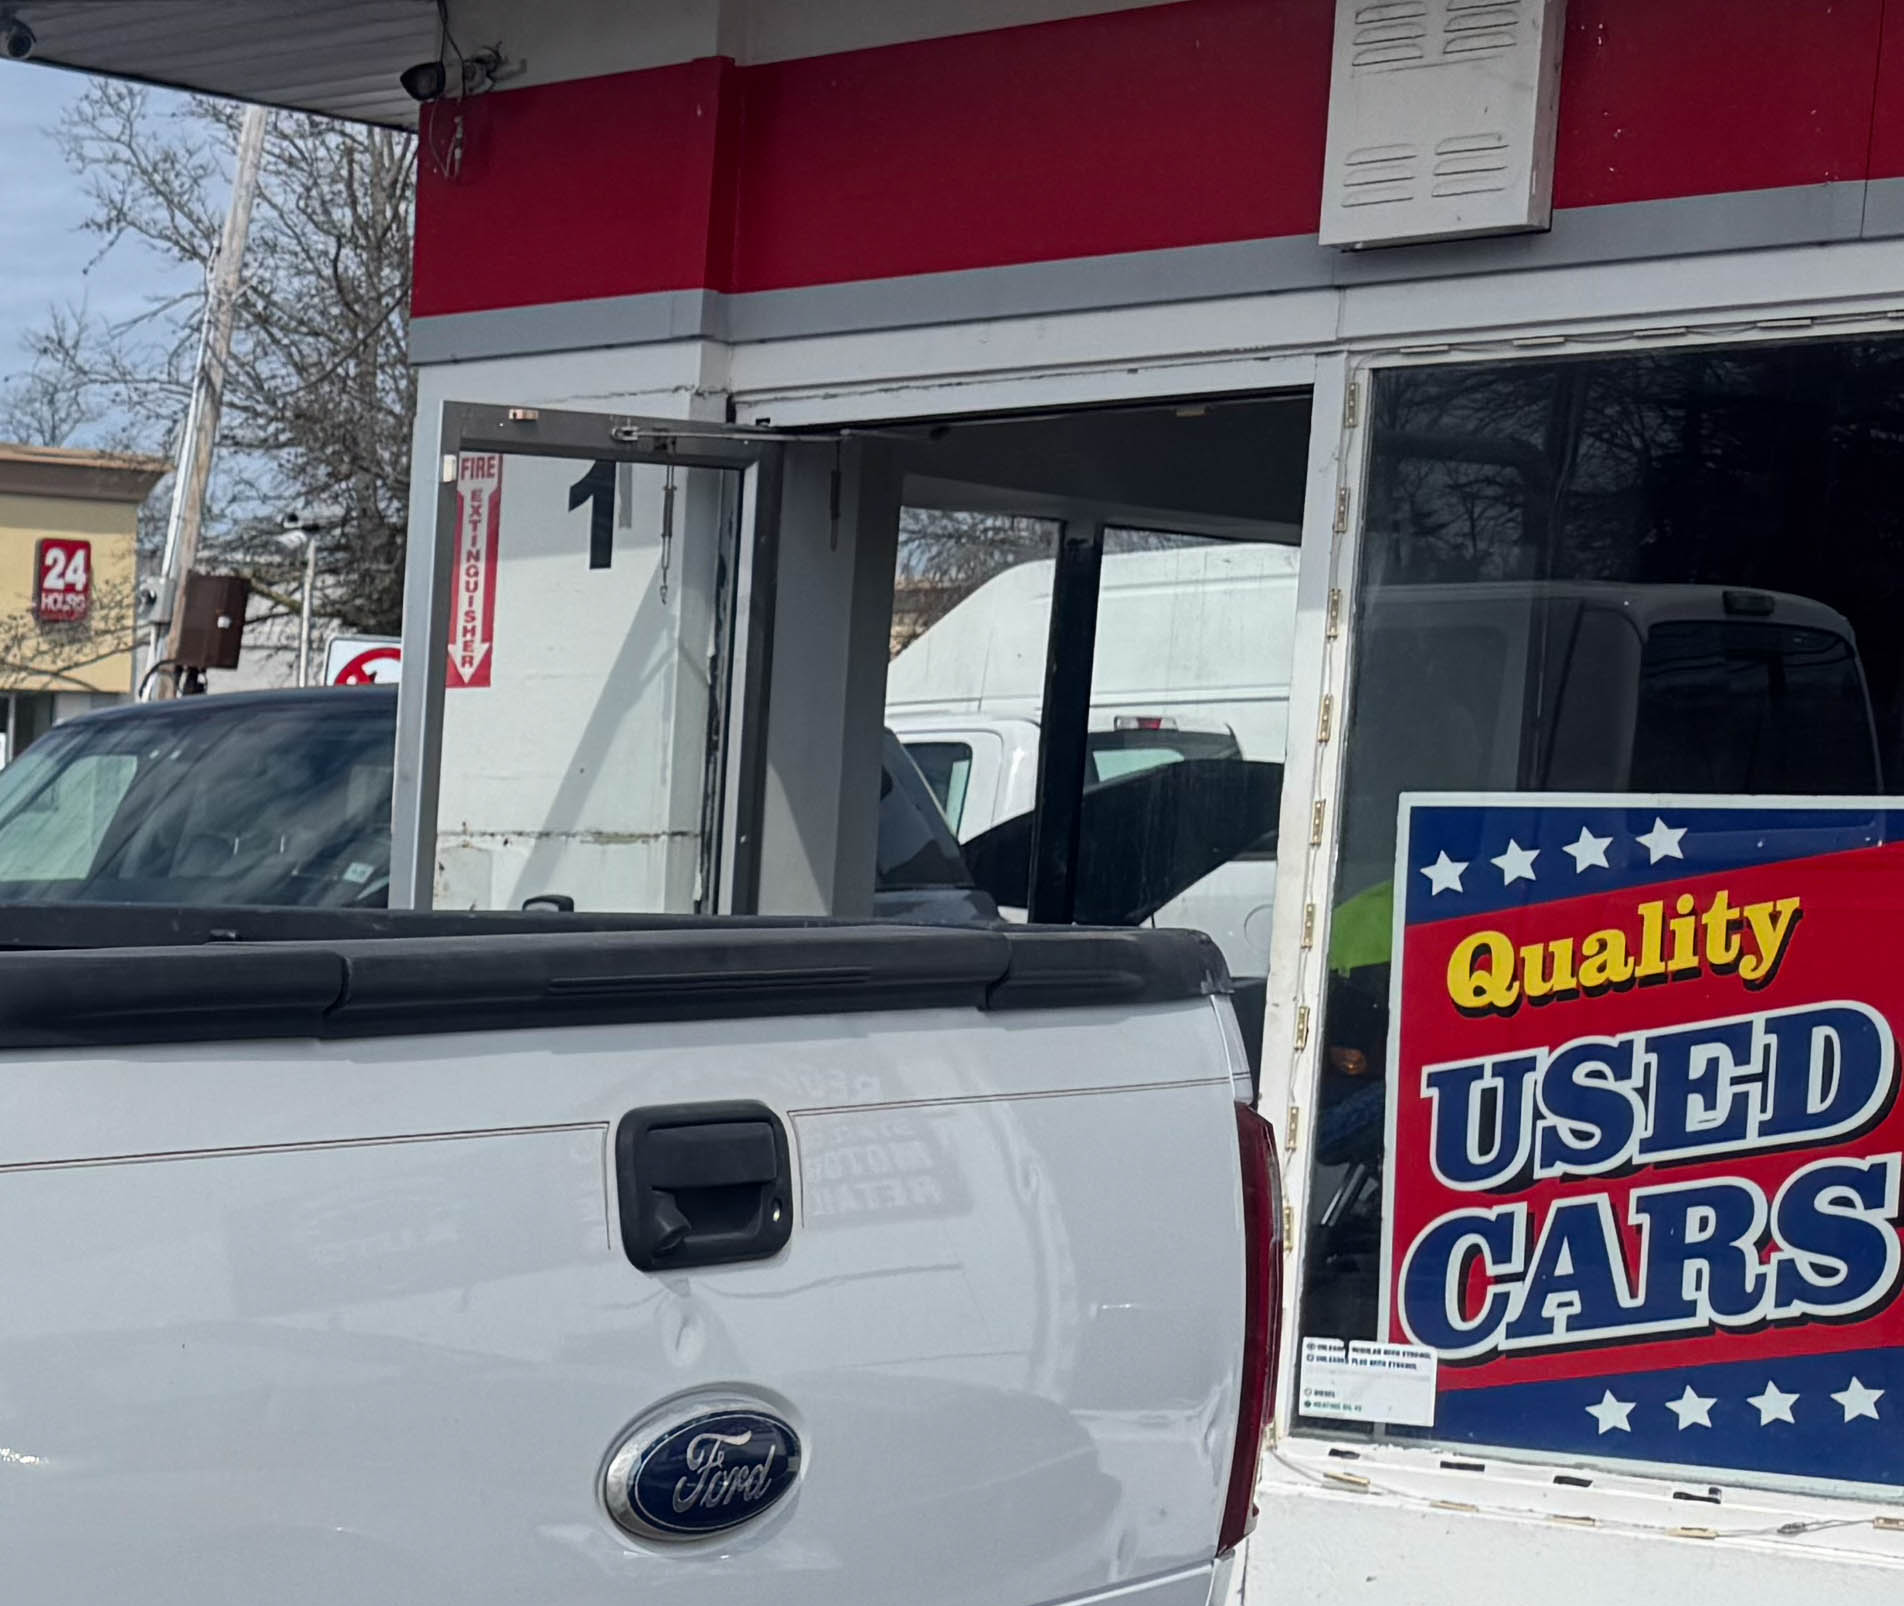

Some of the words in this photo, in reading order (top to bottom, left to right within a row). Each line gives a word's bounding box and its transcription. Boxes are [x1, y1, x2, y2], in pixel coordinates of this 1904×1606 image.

[460, 456, 495, 480] FIRE
[42, 547, 87, 592] 24
[461, 489, 483, 668] EXTINGUISHER
[1447, 890, 1801, 1009] Quality
[1421, 1000, 1896, 1192] USED
[1398, 1152, 1903, 1360] CARS
[672, 1430, 776, 1513] Ford
